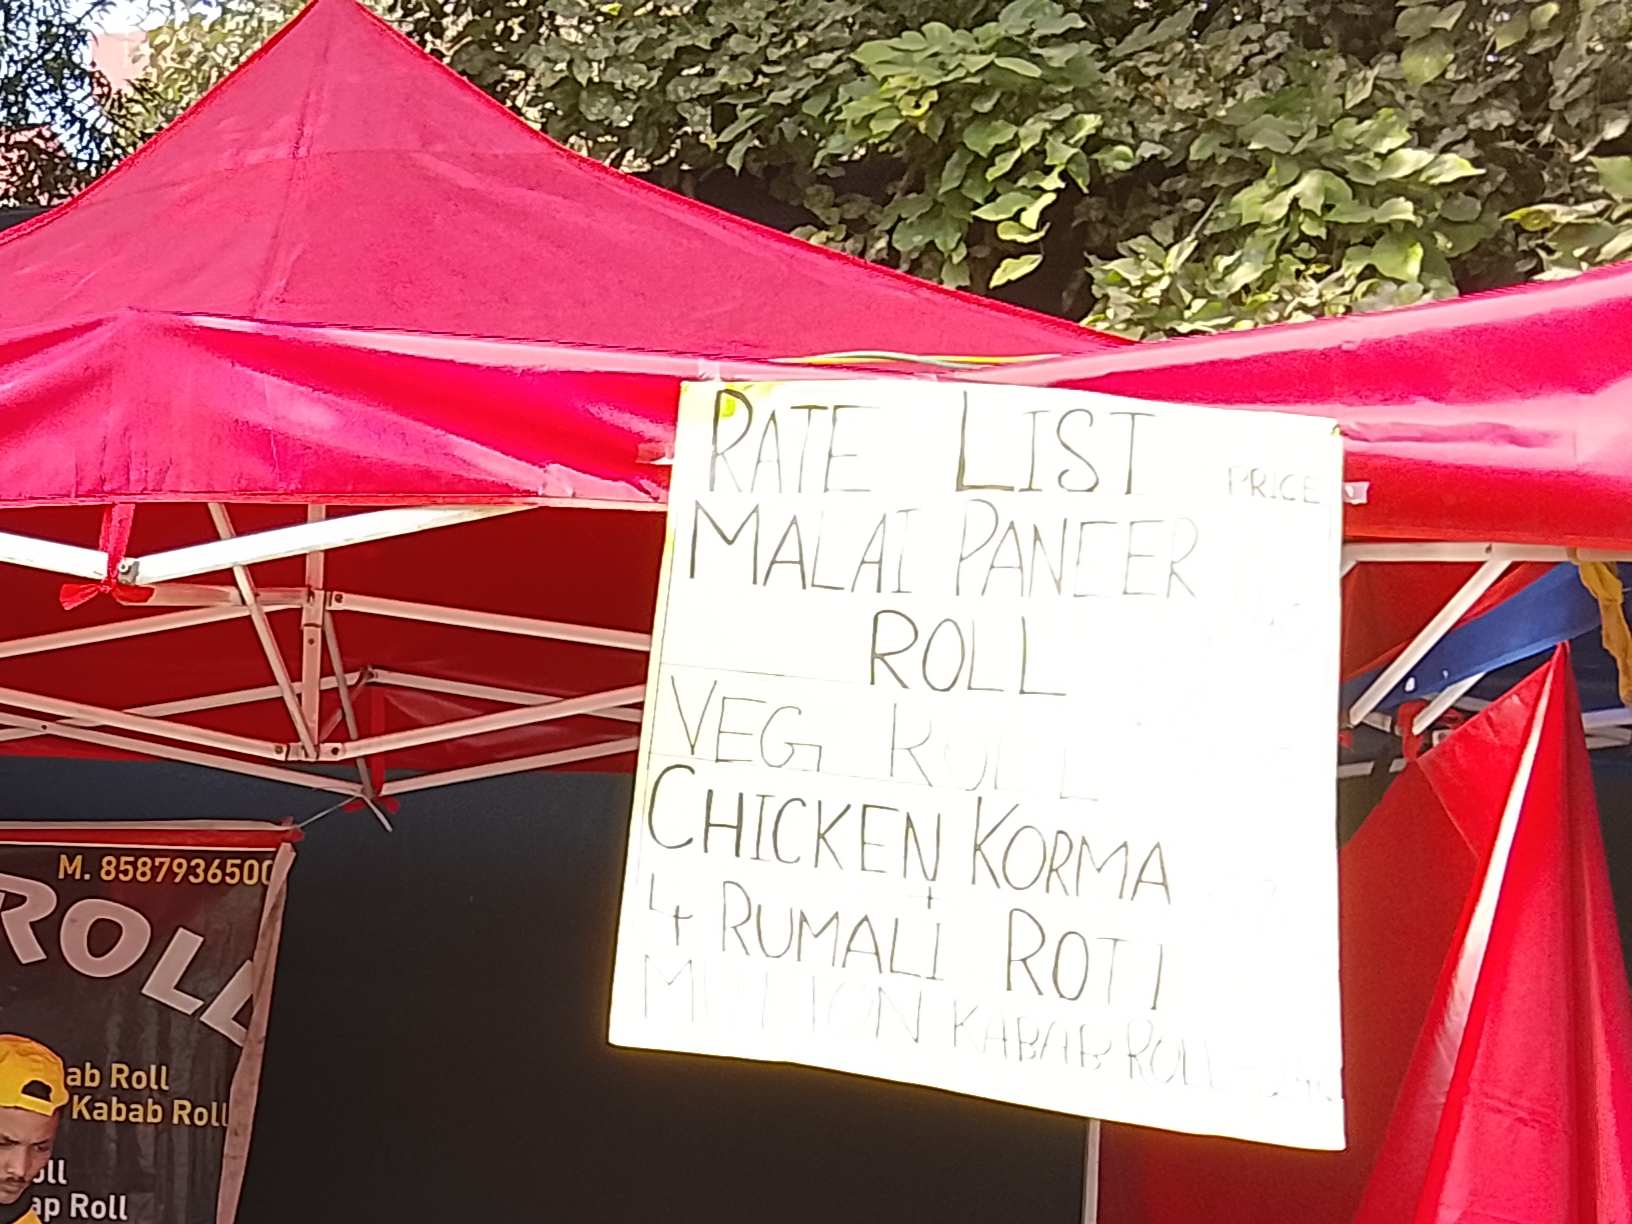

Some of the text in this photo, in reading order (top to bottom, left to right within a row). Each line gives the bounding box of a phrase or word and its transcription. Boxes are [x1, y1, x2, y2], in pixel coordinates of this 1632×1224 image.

[709, 389, 880, 494] RATE
[955, 390, 1157, 496] LIST
[689, 500, 919, 592] MALAI
[870, 610, 1067, 696] ROLL
[670, 674, 823, 772] VEG
[58, 854, 91, 880] M.
[647, 764, 1171, 904] CHICKEN KORMA
[721, 880, 944, 981] RUMALI
[1005, 909, 1166, 1010] ROTI
[72, 1095, 163, 1124] Kabab
[172, 1100, 229, 1128] Roll
[111, 1063, 169, 1091] Roll
[70, 1193, 128, 1220] Roll
